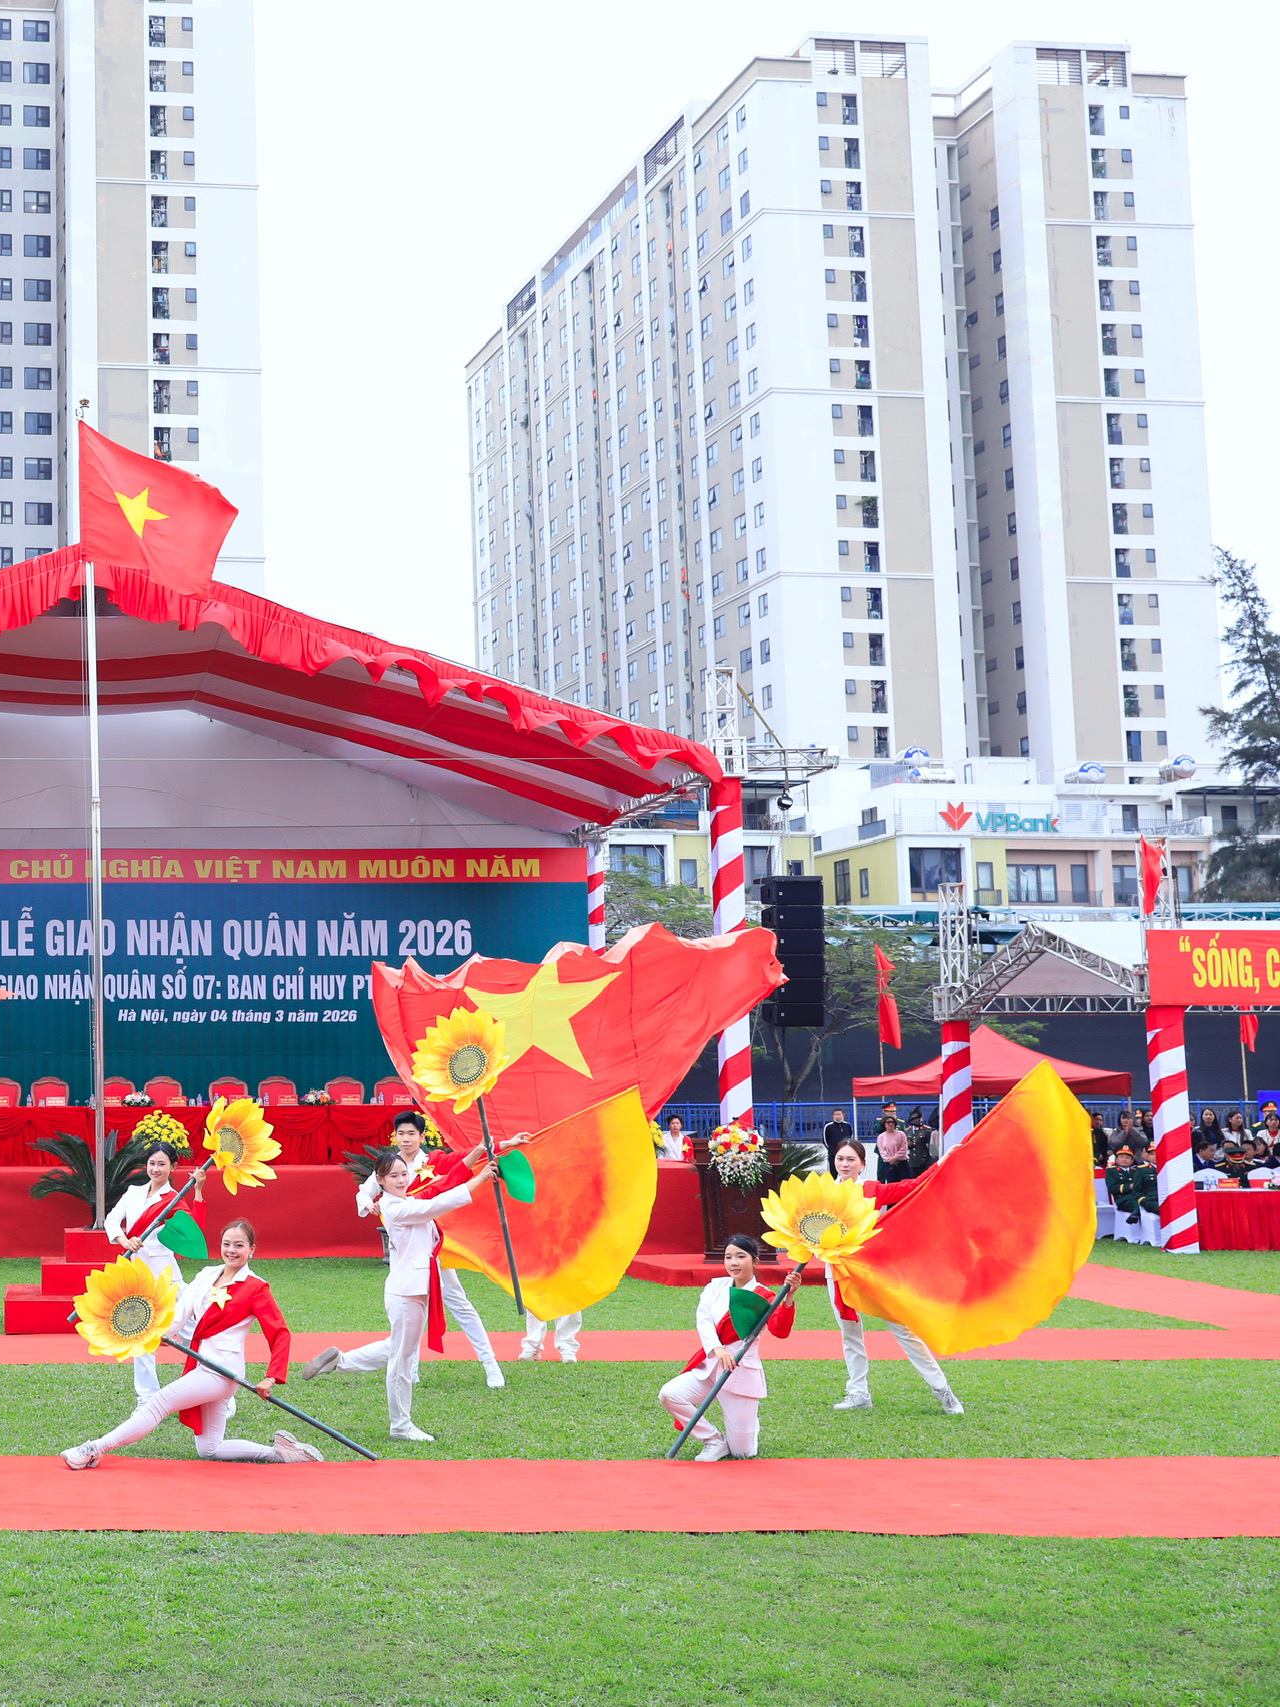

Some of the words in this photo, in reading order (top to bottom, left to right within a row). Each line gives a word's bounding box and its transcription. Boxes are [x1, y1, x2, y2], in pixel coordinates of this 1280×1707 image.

[976, 812, 1060, 833] VPBank
[9, 854, 73, 879] CHỦ
[84, 855, 185, 879] NGHĨA
[194, 855, 262, 884] VIỆT
[272, 859, 347, 879] NAM
[358, 855, 455, 879] MUÔN
[466, 854, 540, 878] NĂM
[0, 906, 35, 957] LỄ
[45, 918, 116, 957] GIAO
[126, 911, 212, 965] NHẬN
[223, 912, 307, 958] QUÂN
[317, 911, 388, 957] NĂM
[398, 918, 473, 957] 2026
[44, 969, 96, 1005] NHẬN
[103, 969, 156, 1002] QUÂN
[161, 965, 187, 1000] SỐ
[192, 974, 222, 1000] 07:
[227, 974, 267, 1000] BAN
[272, 966, 304, 1000] CHỈ
[310, 974, 347, 1000] HUY
[352, 974, 374, 1000] PT
[117, 1008, 137, 1022] Hà
[140, 1008, 169, 1025] Nội,
[172, 1010, 208, 1024] ngày
[210, 1009, 228, 1022] 04
[231, 1009, 272, 1024] tháng
[274, 1009, 285, 1022] 3
[287, 1009, 319, 1022] năm
[321, 1009, 358, 1022] 2026
